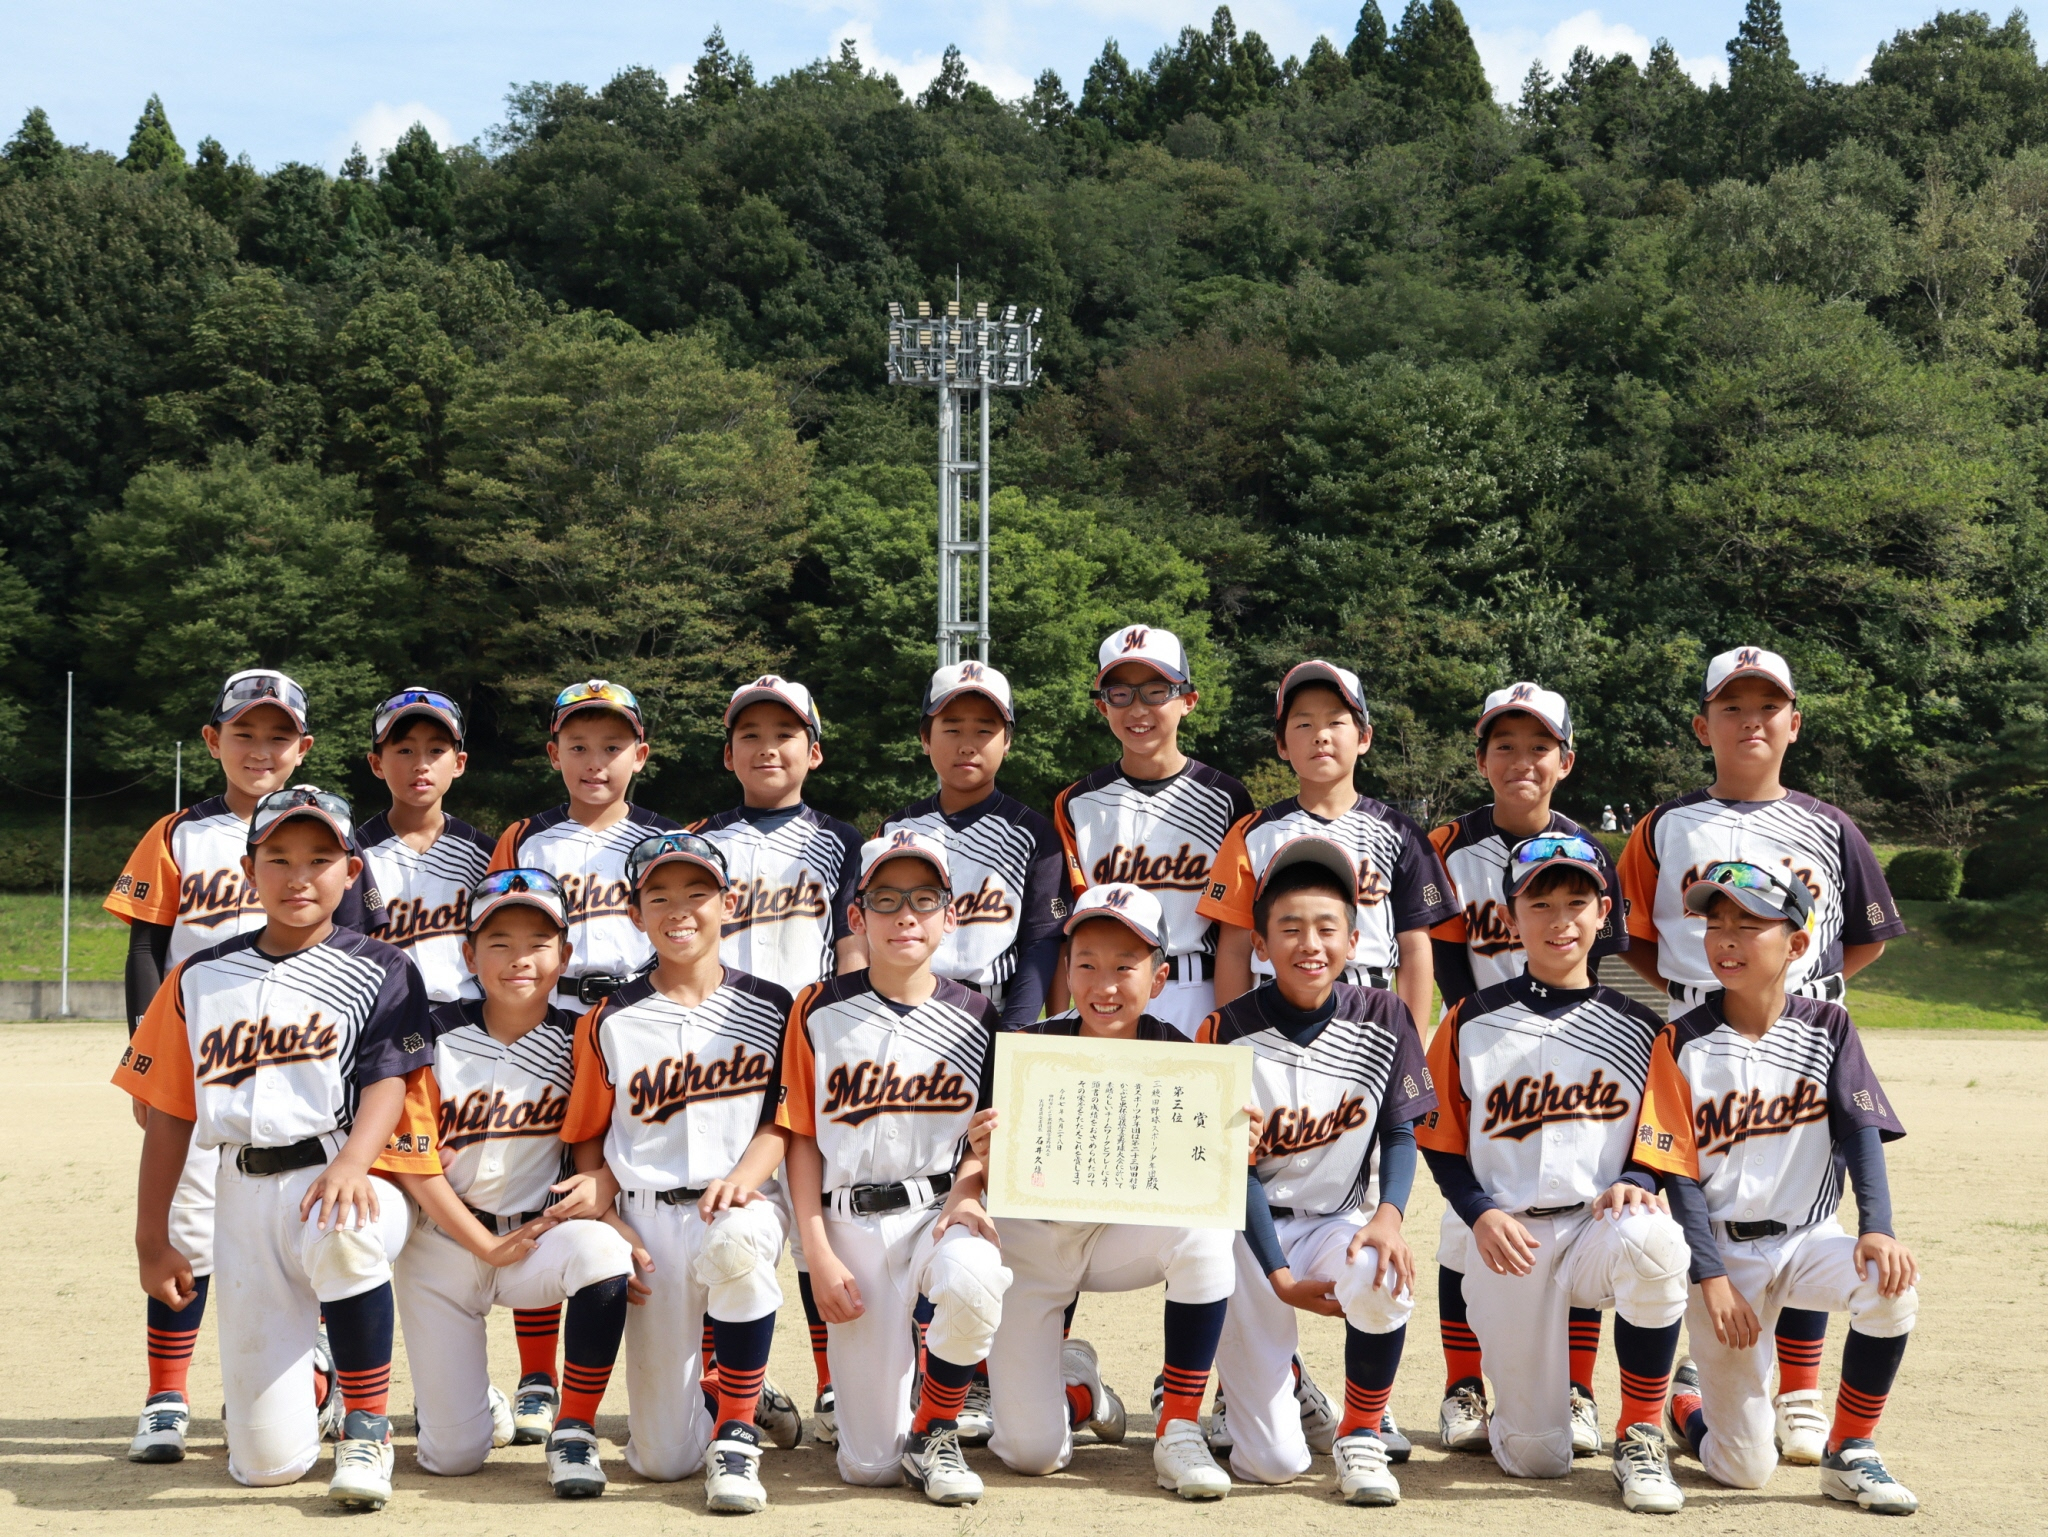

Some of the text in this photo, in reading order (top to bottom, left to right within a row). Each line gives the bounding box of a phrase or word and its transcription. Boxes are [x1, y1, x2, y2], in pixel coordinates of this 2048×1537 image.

[1121, 629, 1149, 654] M
[1734, 649, 1762, 670] M
[959, 662, 985, 682] M
[1508, 684, 1534, 703] M
[892, 829, 919, 848] M
[1093, 843, 1211, 886] Mihota
[1105, 888, 1134, 910] M
[196, 1011, 340, 1080] Mihota
[629, 1044, 770, 1116] Mihota
[823, 1059, 973, 1113] Mihota
[438, 1084, 568, 1146] Mihota
[1172, 1086, 1184, 1123] 第三位
[1482, 1068, 1626, 1133] Mihota
[1696, 1077, 1826, 1150] Mihota
[385, 1132, 430, 1153] 穂田
[1191, 1112, 1208, 1162] 賞状
